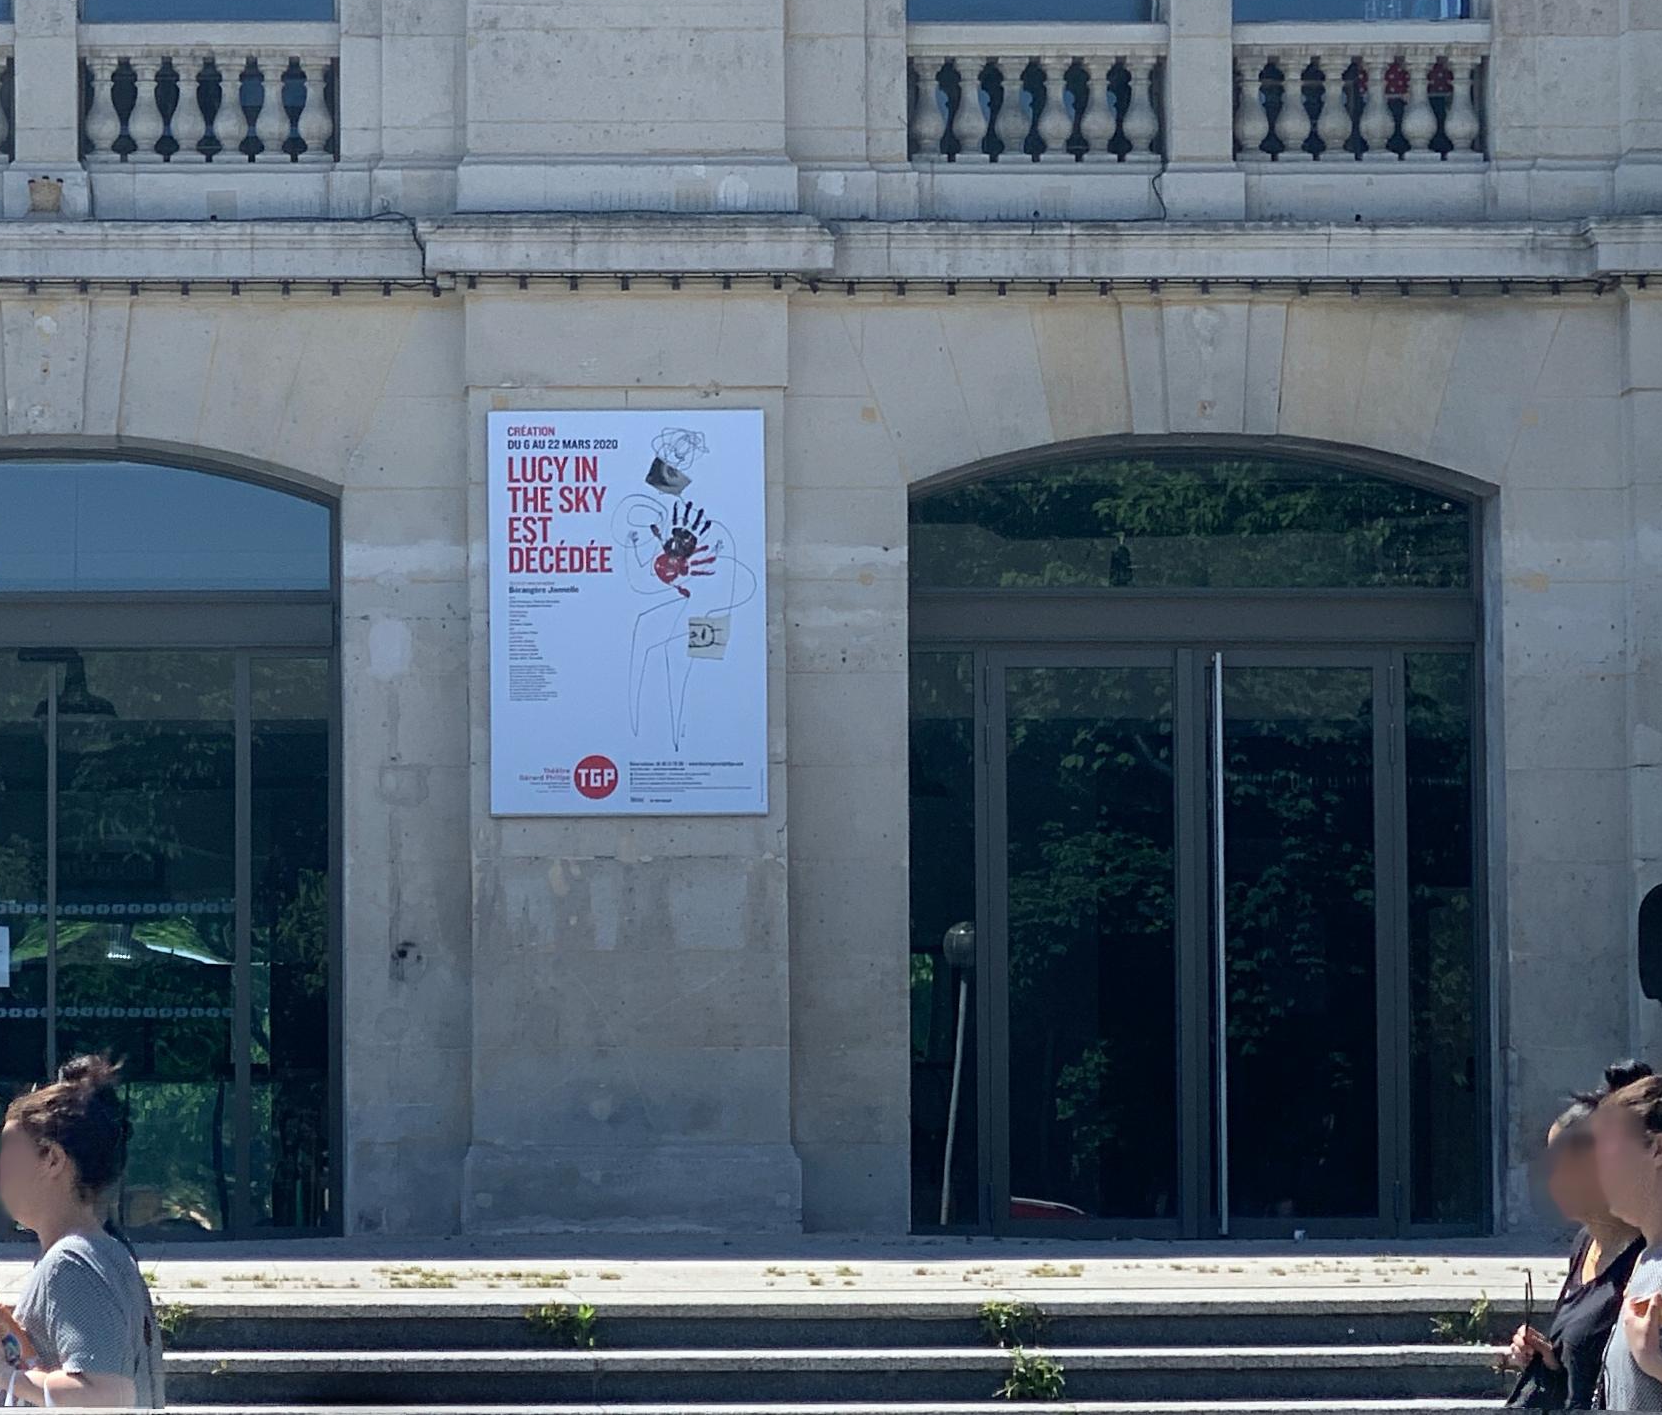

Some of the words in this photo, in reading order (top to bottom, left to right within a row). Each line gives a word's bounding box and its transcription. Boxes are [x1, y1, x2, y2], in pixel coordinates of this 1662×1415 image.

[507, 426, 555, 436] CRÉATION
[507, 440, 521, 450] DU
[524, 440, 530, 450] 6
[532, 440, 546, 450] AU
[547, 440, 560, 450] 22
[562, 440, 591, 450] MARS
[593, 440, 618, 450] 2020
[507, 456, 569, 483] LUCY
[575, 456, 598, 483] IN
[507, 486, 553, 513] THE
[559, 486, 606, 513] SKY
[508, 516, 552, 544] EST
[509, 540, 613, 574] DÉCÉDÉE
[578, 769, 615, 787] TGP
